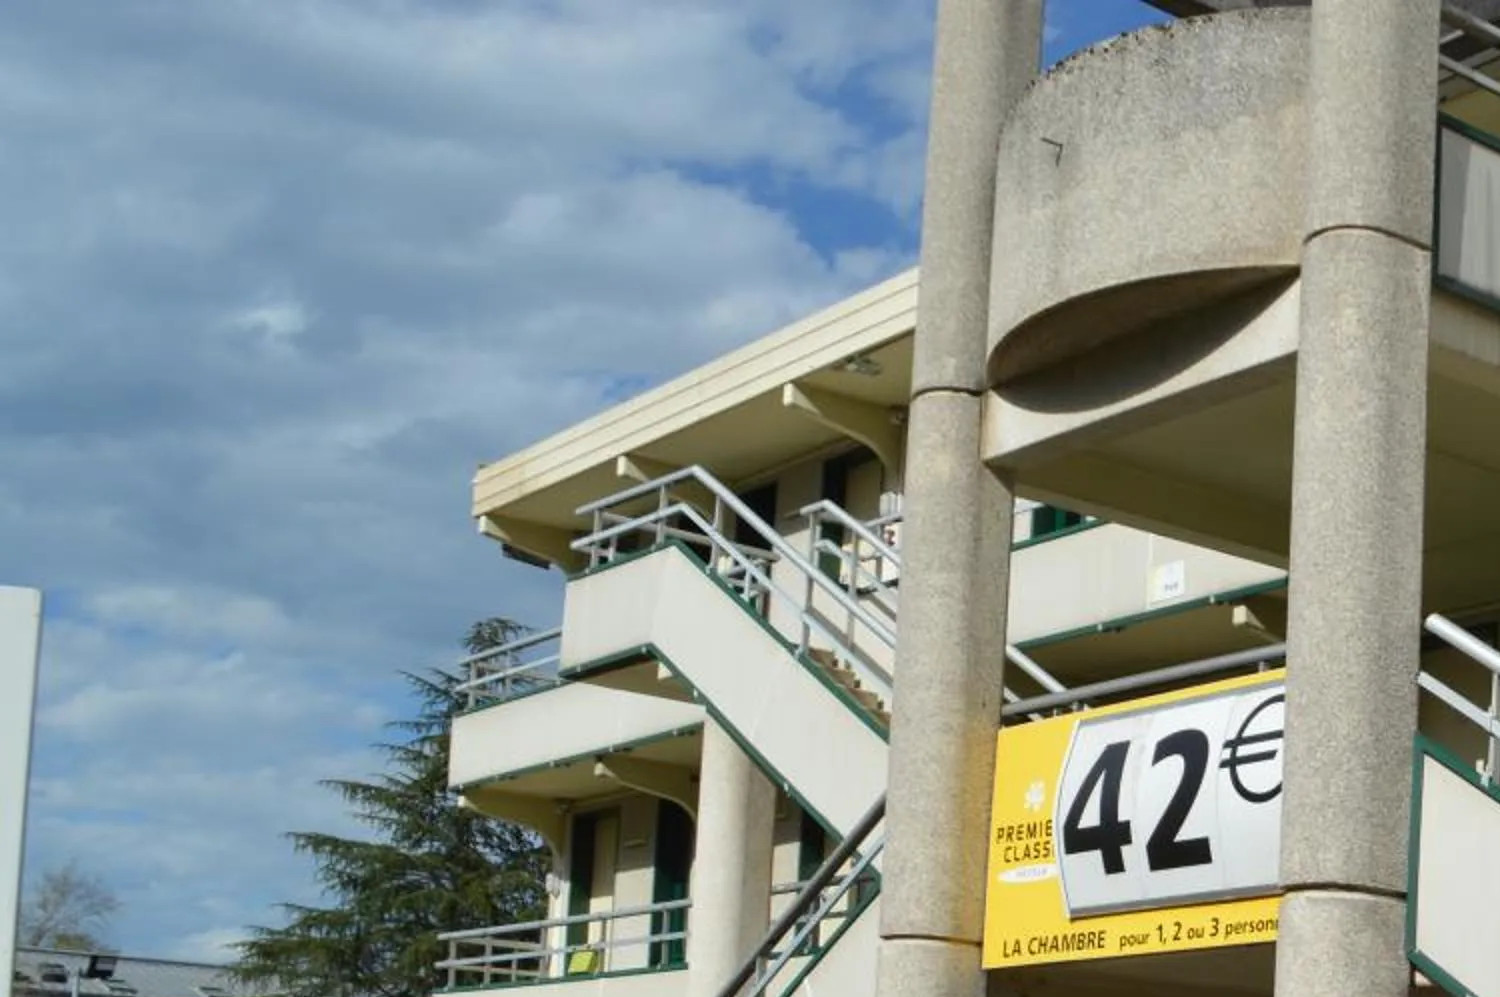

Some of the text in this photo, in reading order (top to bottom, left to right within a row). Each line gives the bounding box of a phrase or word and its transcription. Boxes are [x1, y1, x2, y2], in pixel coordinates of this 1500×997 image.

[996, 819, 1053, 843] PREMIE
[1003, 938, 1021, 958] LA
[1027, 930, 1106, 956] CHAMBRE
[1119, 933, 1150, 951] pour
[1172, 920, 1182, 941] 2
[1187, 927, 1205, 939] ou
[1209, 917, 1219, 937] 3
